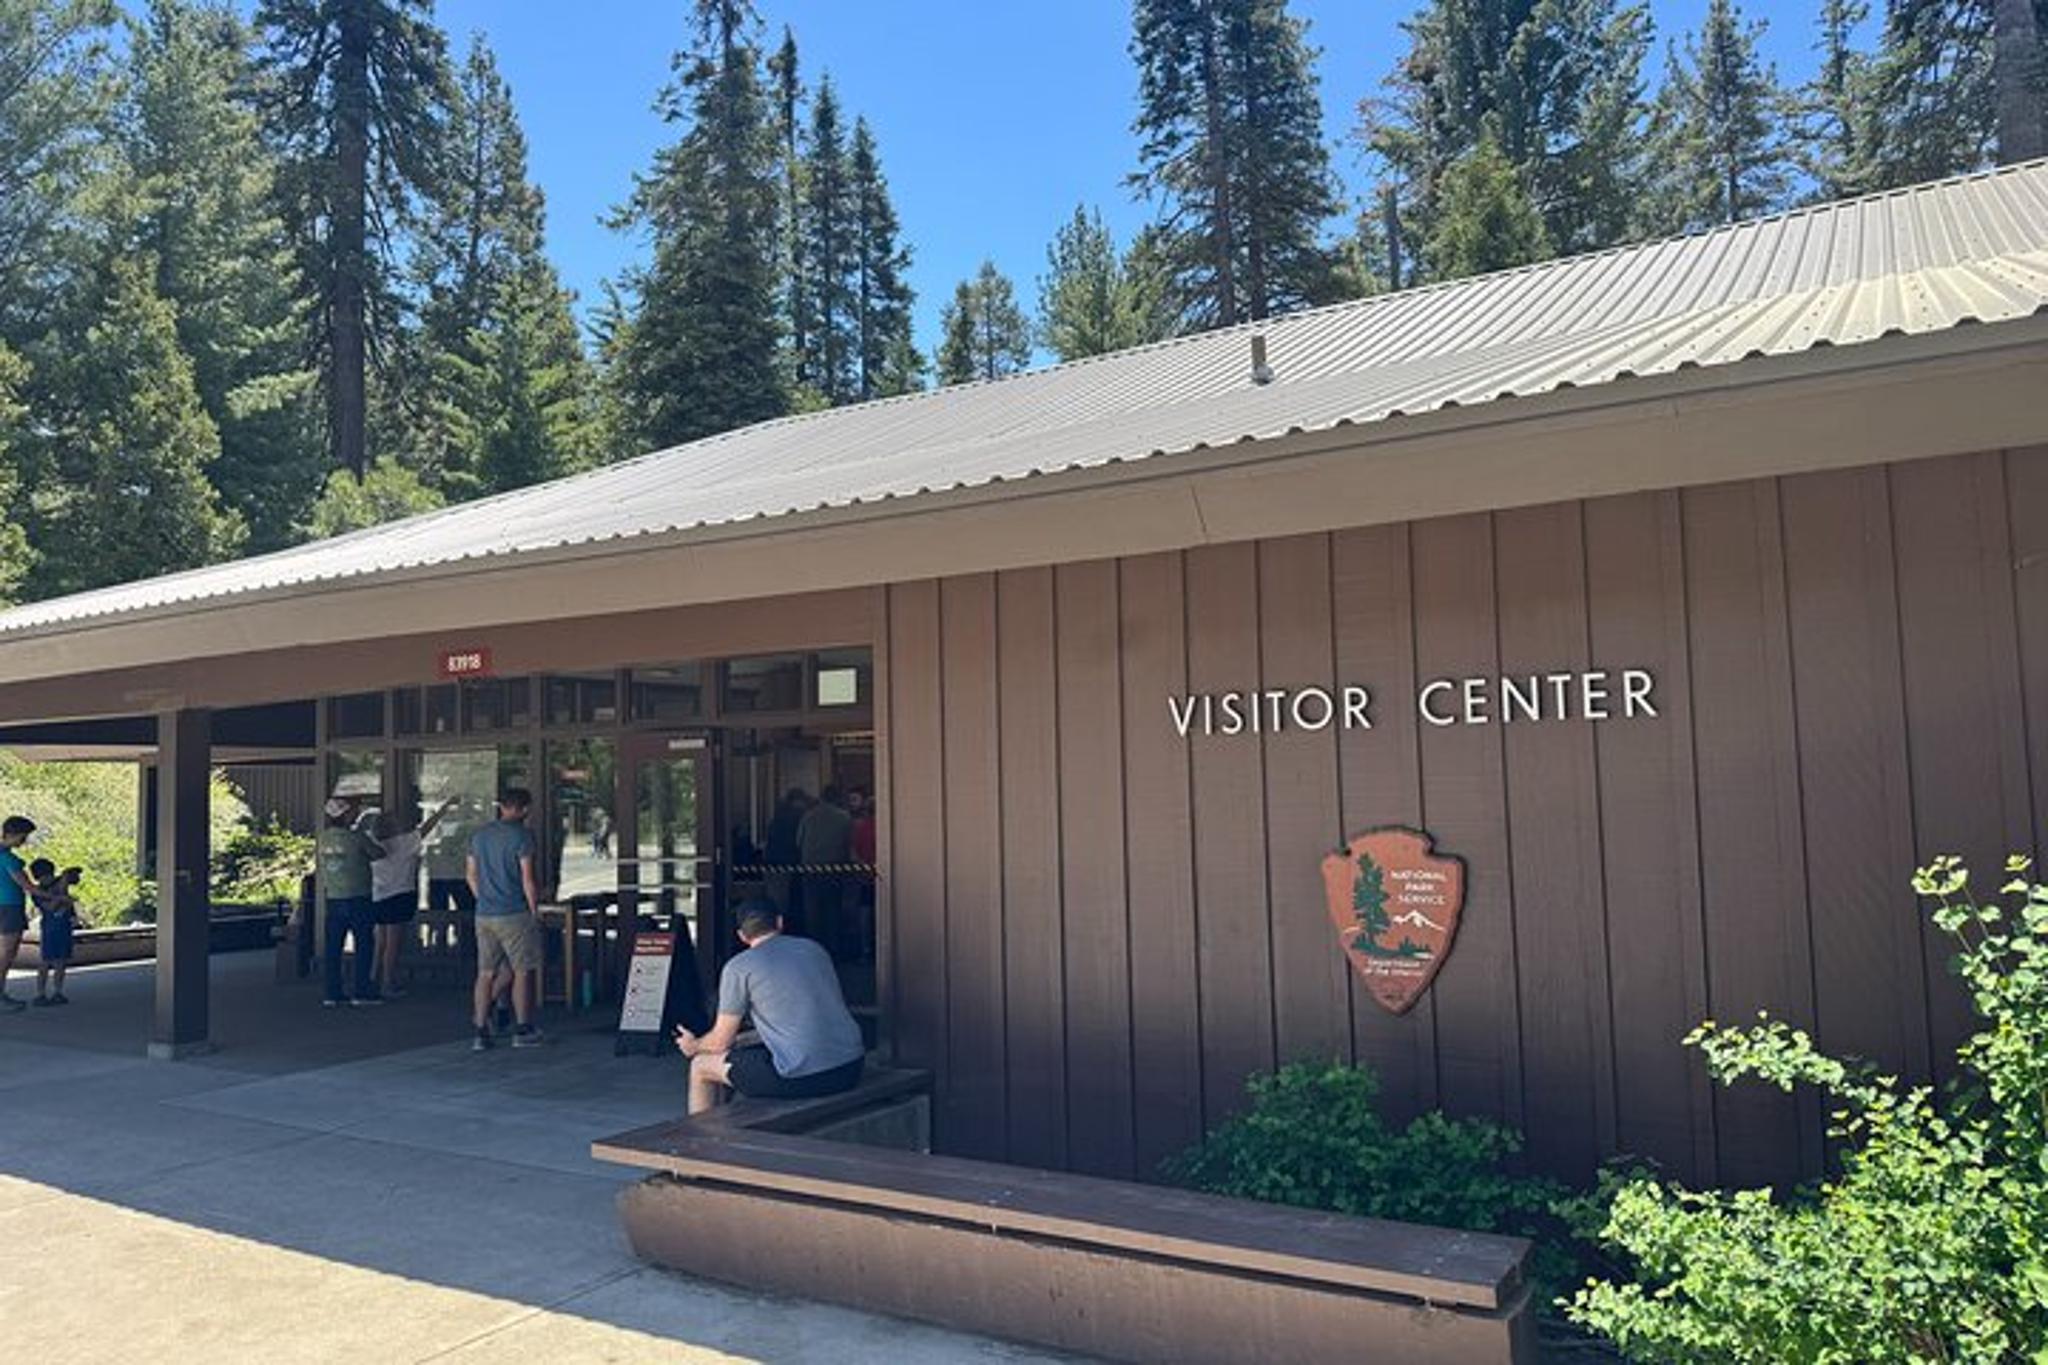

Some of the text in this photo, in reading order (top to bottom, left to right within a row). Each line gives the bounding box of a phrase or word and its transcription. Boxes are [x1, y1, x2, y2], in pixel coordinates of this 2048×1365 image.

[1168, 670, 1658, 737] VISITOR CENTER
[1390, 869, 1448, 882] NATIONAL
[1404, 882, 1435, 892] PARK
[1398, 893, 1447, 906] SERVICE
